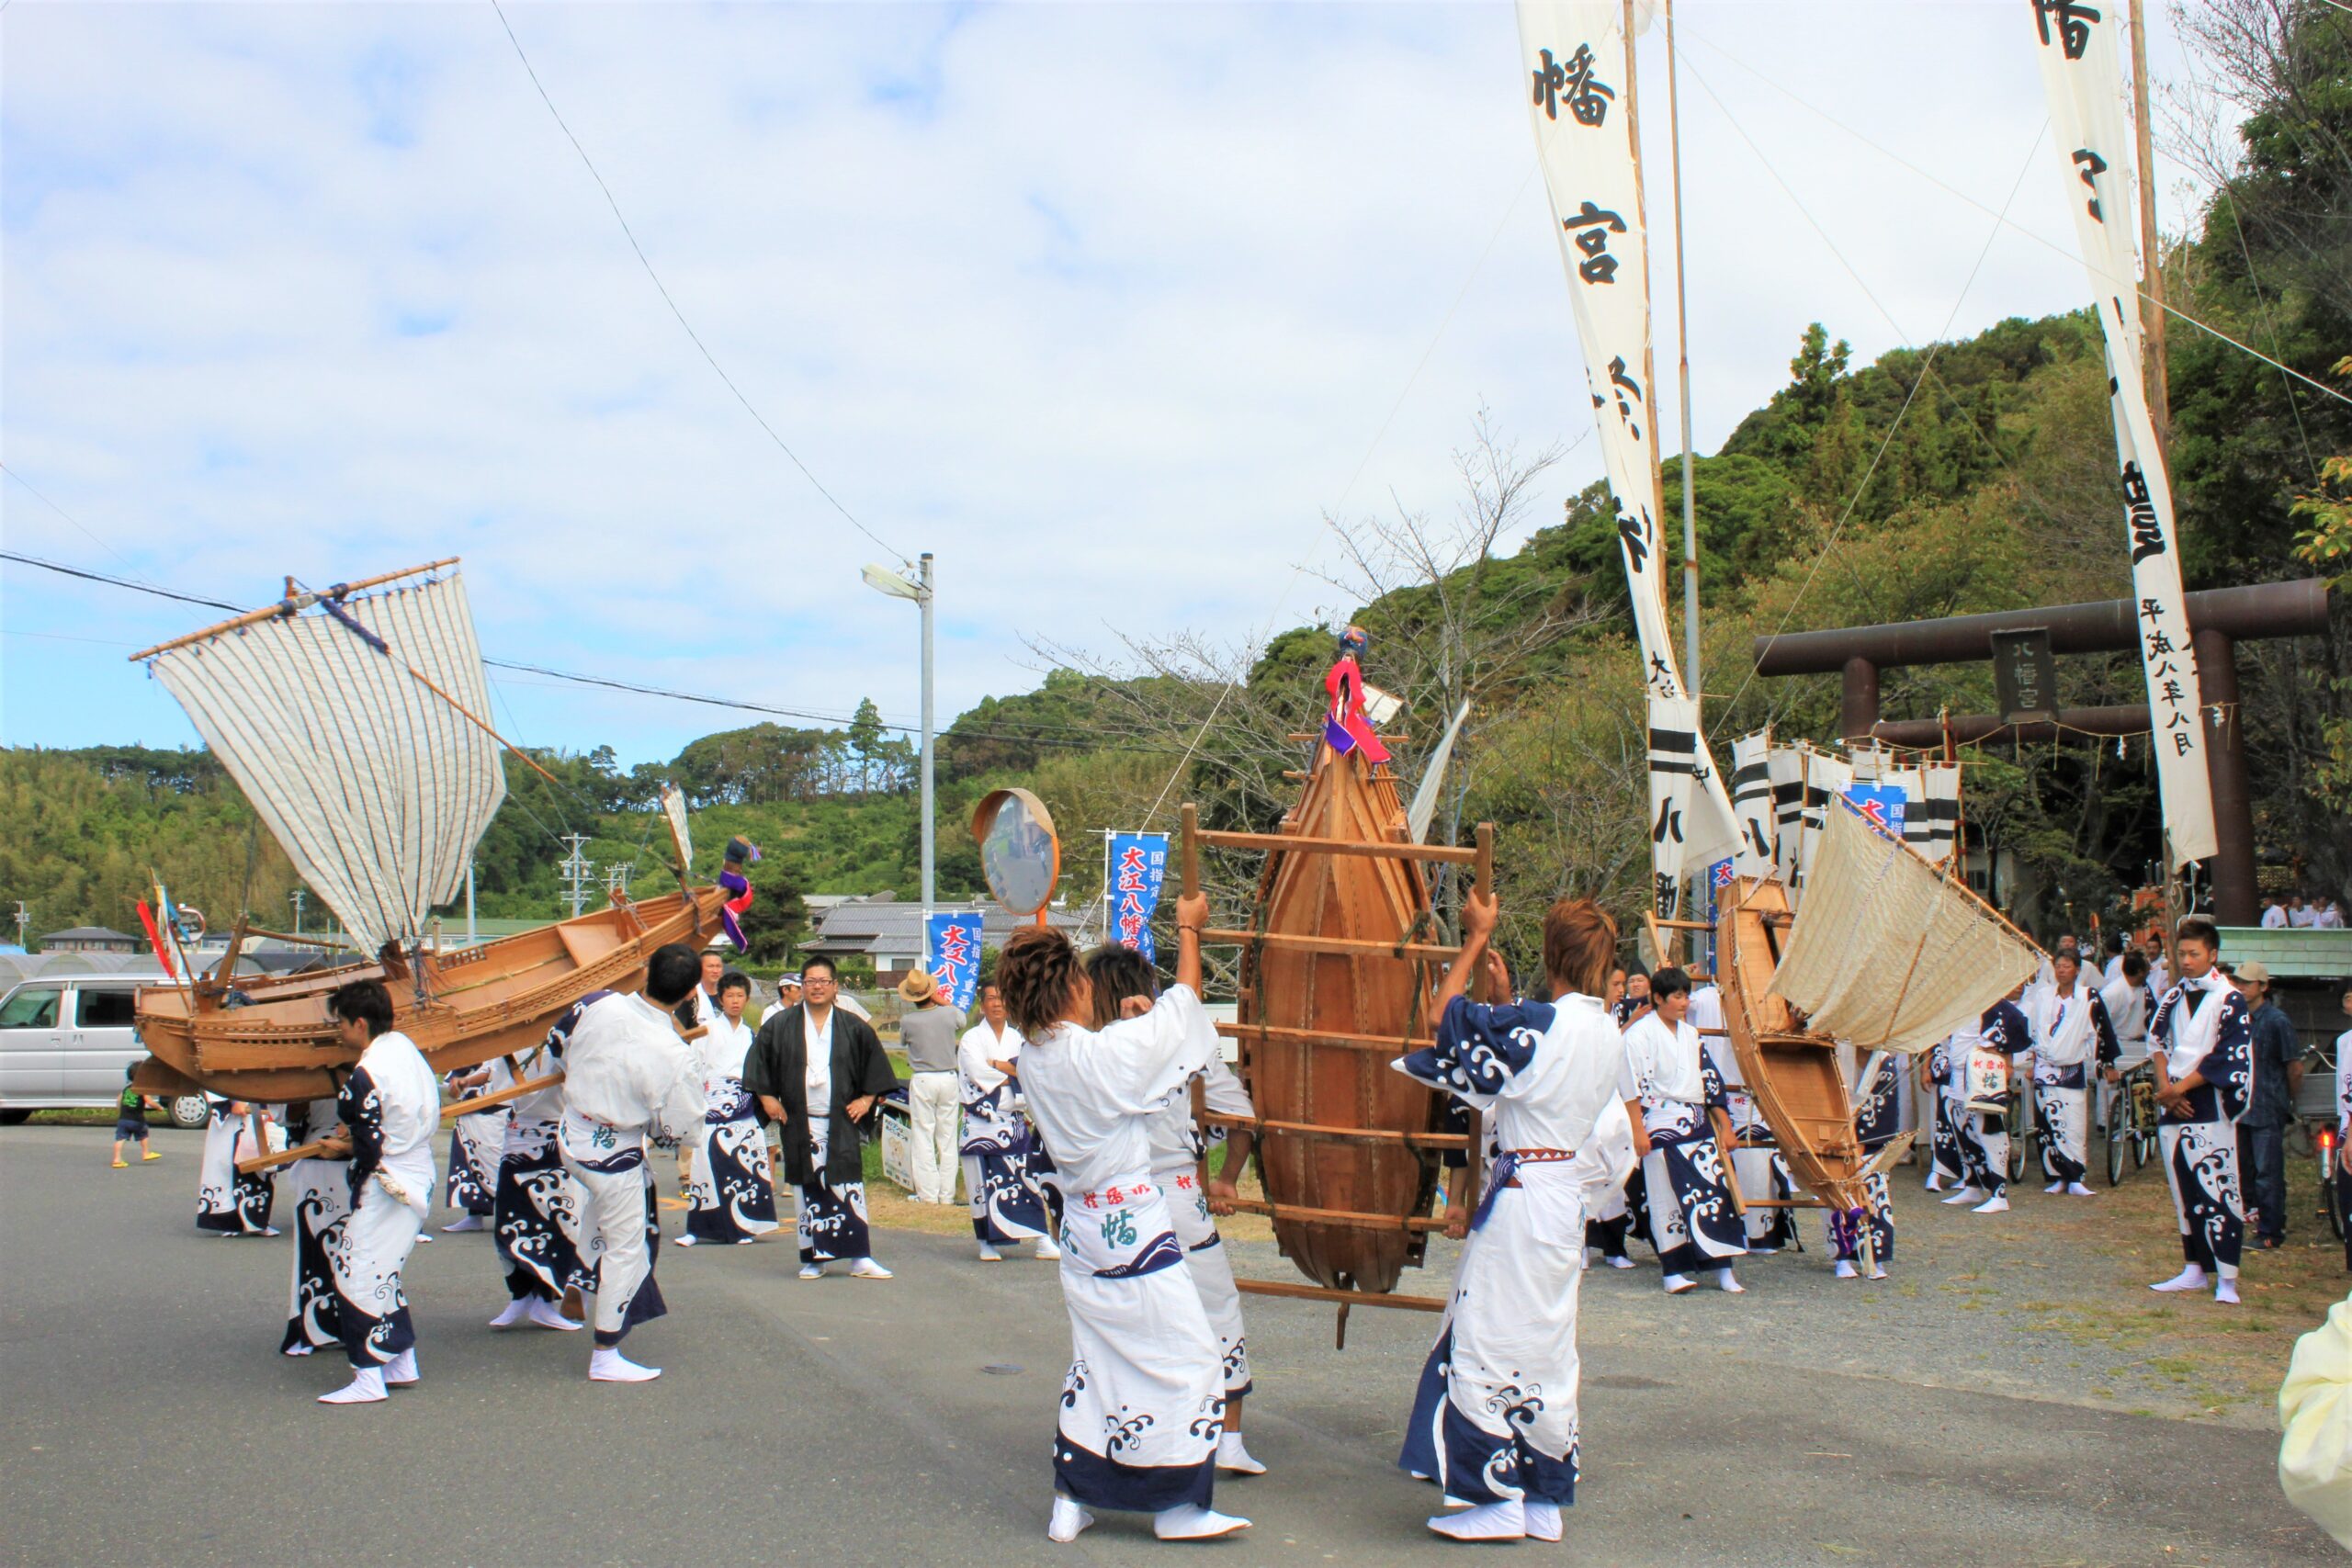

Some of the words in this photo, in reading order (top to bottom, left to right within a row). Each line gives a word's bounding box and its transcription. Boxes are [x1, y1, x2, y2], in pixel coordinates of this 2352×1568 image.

[2012, 642, 2038, 708] 八幡宮
[2141, 598, 2194, 757] 平成八年八月
